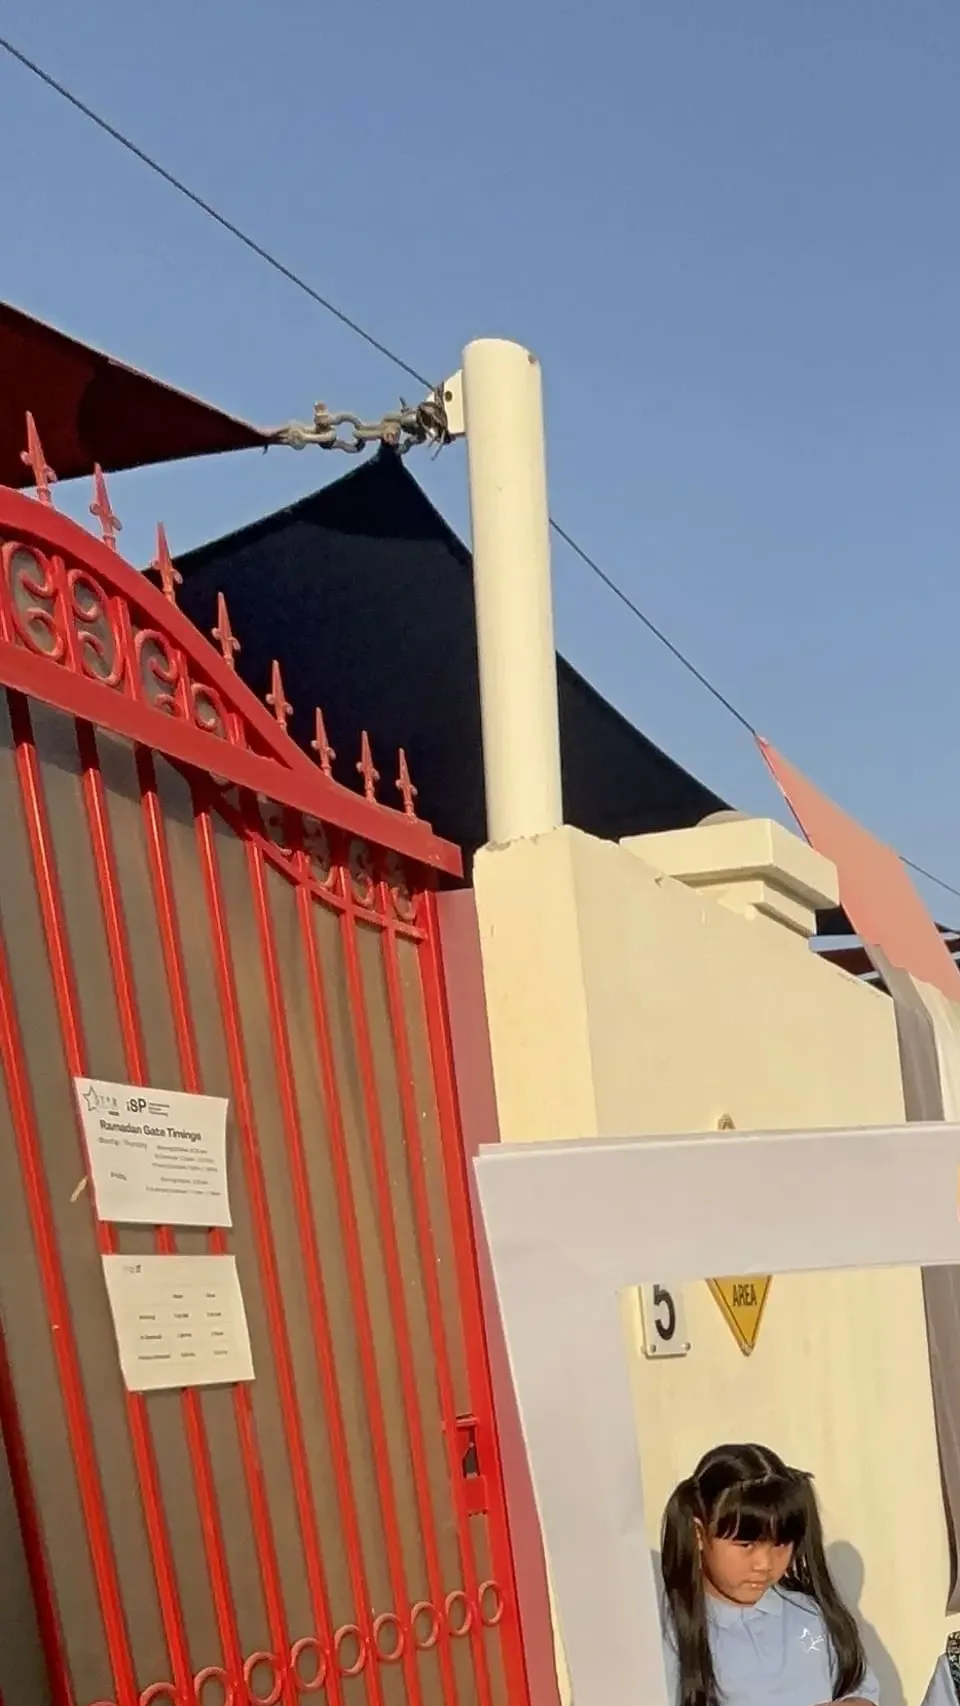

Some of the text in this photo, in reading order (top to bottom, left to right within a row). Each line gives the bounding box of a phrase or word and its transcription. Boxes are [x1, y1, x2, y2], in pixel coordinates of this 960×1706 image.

[99, 1119, 202, 1142] Ramadan Gate Timings
[732, 1284, 758, 1307] AREA
